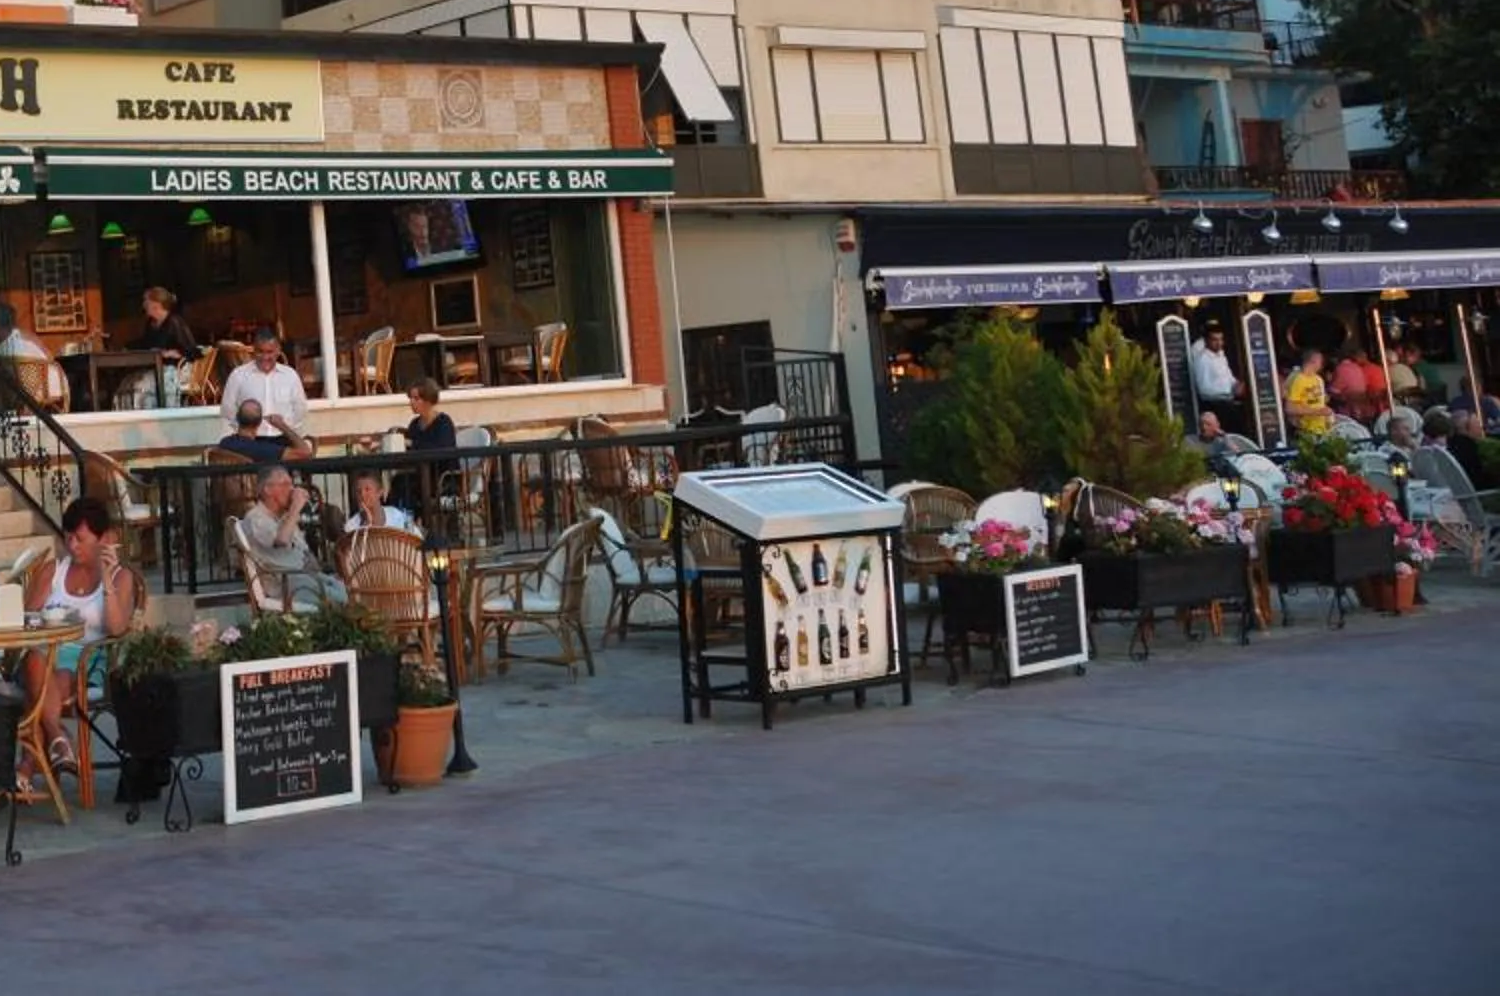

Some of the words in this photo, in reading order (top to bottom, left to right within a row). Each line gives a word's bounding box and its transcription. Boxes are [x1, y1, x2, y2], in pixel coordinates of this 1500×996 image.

[164, 62, 235, 83] CAFE
[116, 100, 293, 122] RESTAURANT
[151, 170, 232, 192] LADIES
[243, 171, 319, 192] BEACH
[328, 171, 463, 192] RESTAURANT
[470, 171, 485, 191] &
[490, 171, 542, 191] CAFE
[547, 171, 562, 190] &
[567, 170, 607, 190] BAR
[270, 665, 334, 685] BREAKFAST
